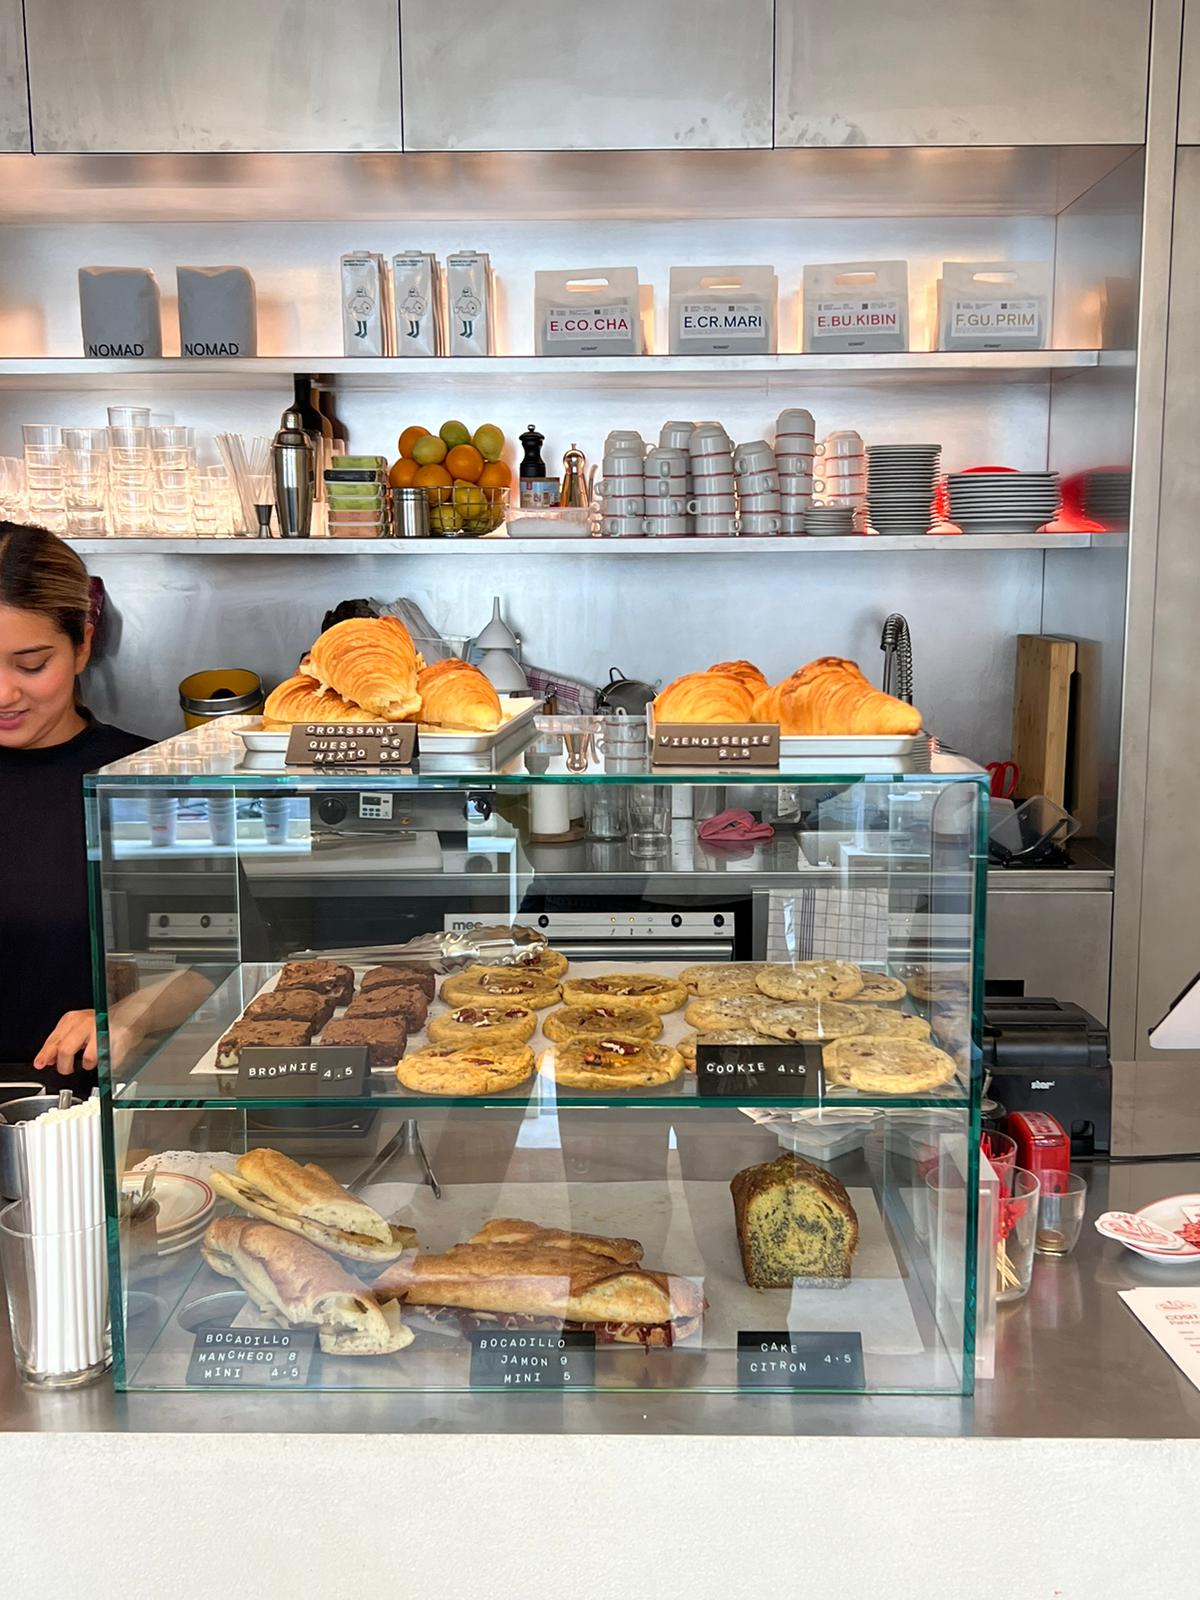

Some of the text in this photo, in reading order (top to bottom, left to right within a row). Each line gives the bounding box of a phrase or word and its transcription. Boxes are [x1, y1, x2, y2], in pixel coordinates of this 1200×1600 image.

[550, 318, 628, 332] E.CO.CHA
[684, 315, 762, 329] E.CR.MARI
[817, 313, 896, 328] E.BU.KIBIN
[955, 313, 1036, 327] F.GU.PRIM
[88, 343, 145, 357] NOMAD
[184, 342, 240, 356] NOMAD
[306, 725, 395, 735] CROISSANT
[660, 735, 770, 746] VIENOISERIE
[719, 748, 750, 757] 2.5
[248, 1062, 353, 1078] BROWNIE 4.5
[706, 1062, 806, 1074] COOKIE 4.5
[205, 1333, 290, 1346] BOCADILLO
[480, 1337, 566, 1349] BOCADILLO
[760, 1342, 799, 1354] CAKE
[198, 1350, 297, 1363] MANCHEGO 8
[500, 1355, 568, 1367] JAMON 9
[204, 1367, 241, 1379] MINI
[750, 1360, 807, 1373] CITRON
[503, 1371, 571, 1383] MINI 5
